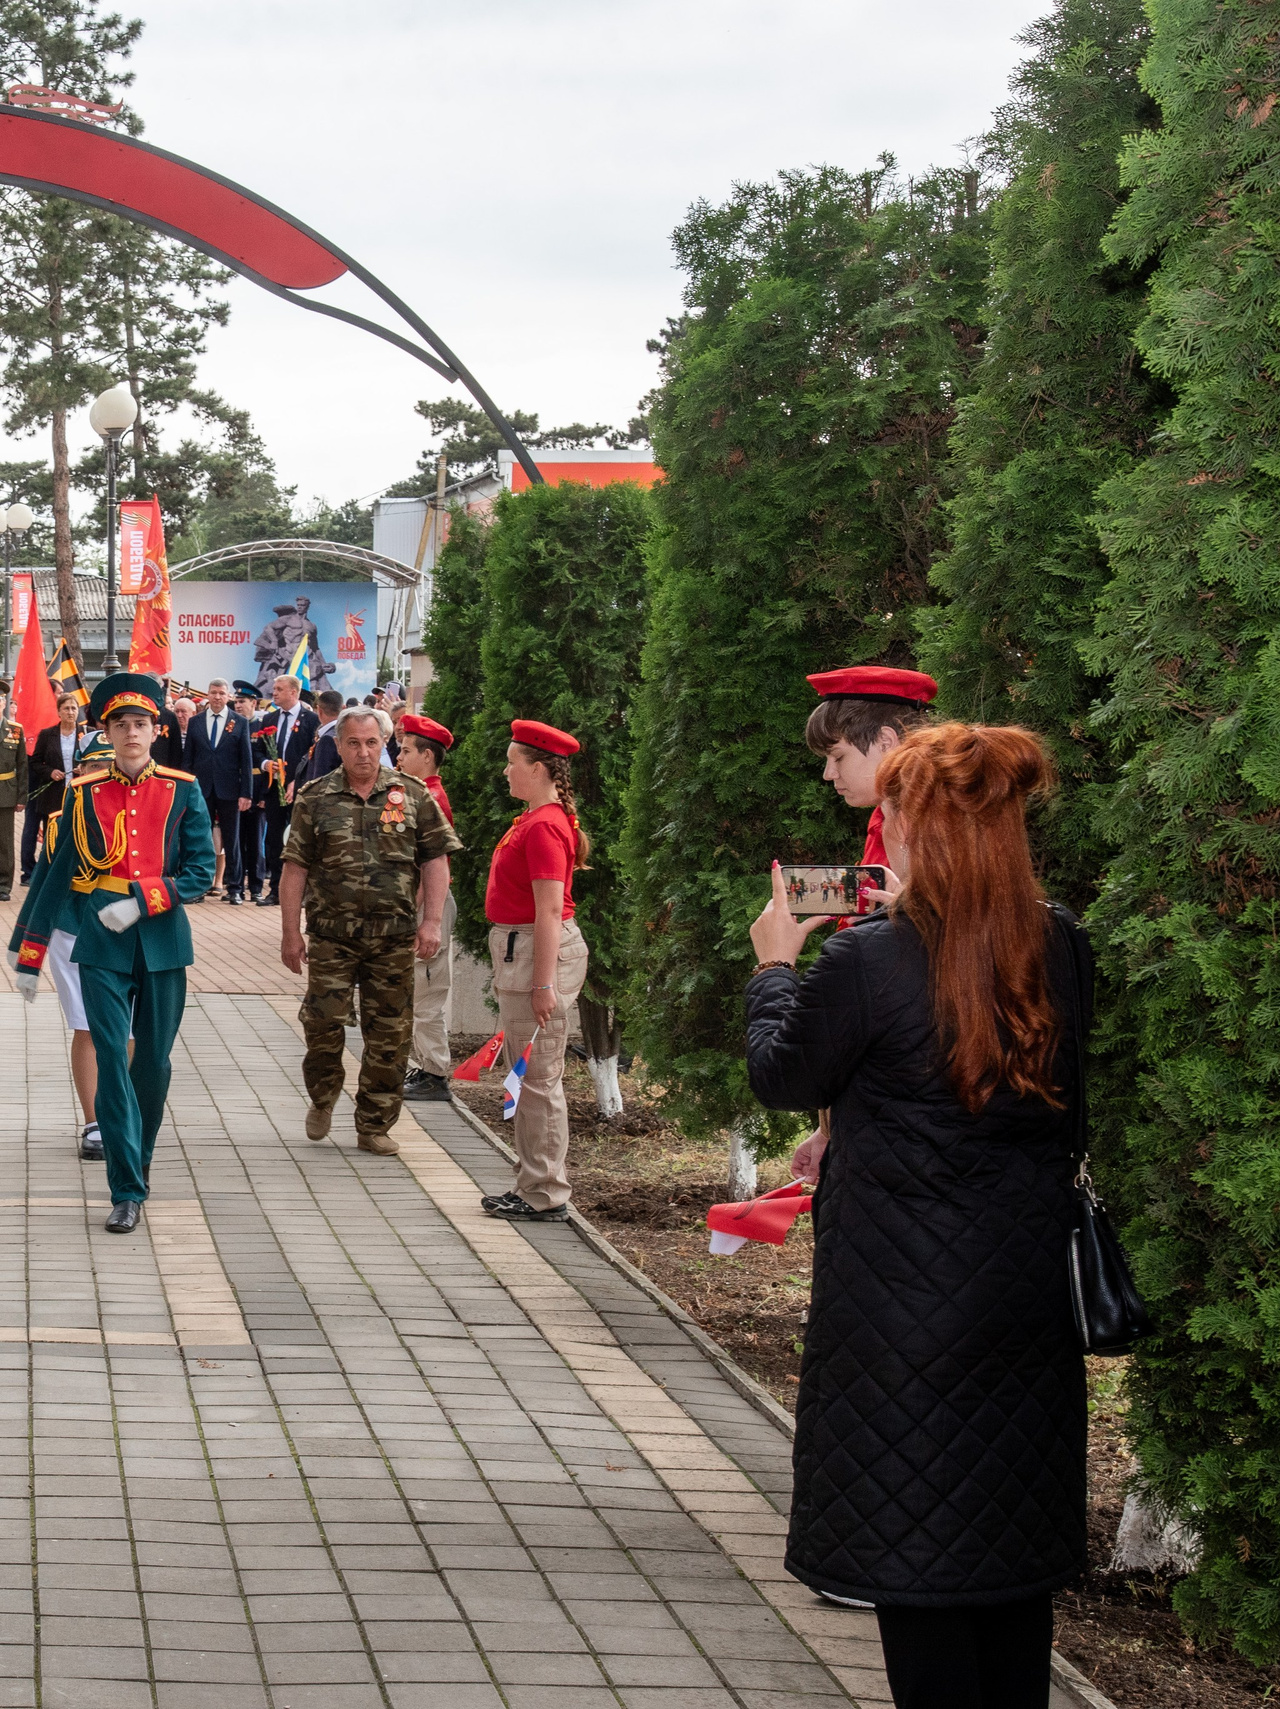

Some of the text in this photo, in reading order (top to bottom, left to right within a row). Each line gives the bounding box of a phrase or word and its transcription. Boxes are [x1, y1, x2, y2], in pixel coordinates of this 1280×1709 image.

[178, 614, 235, 627] СПАСИБО
[178, 630, 251, 646] ЗА ПОБЕДУ!
[337, 636, 353, 650] 80
[337, 652, 366, 660] ПОБЕДА!
